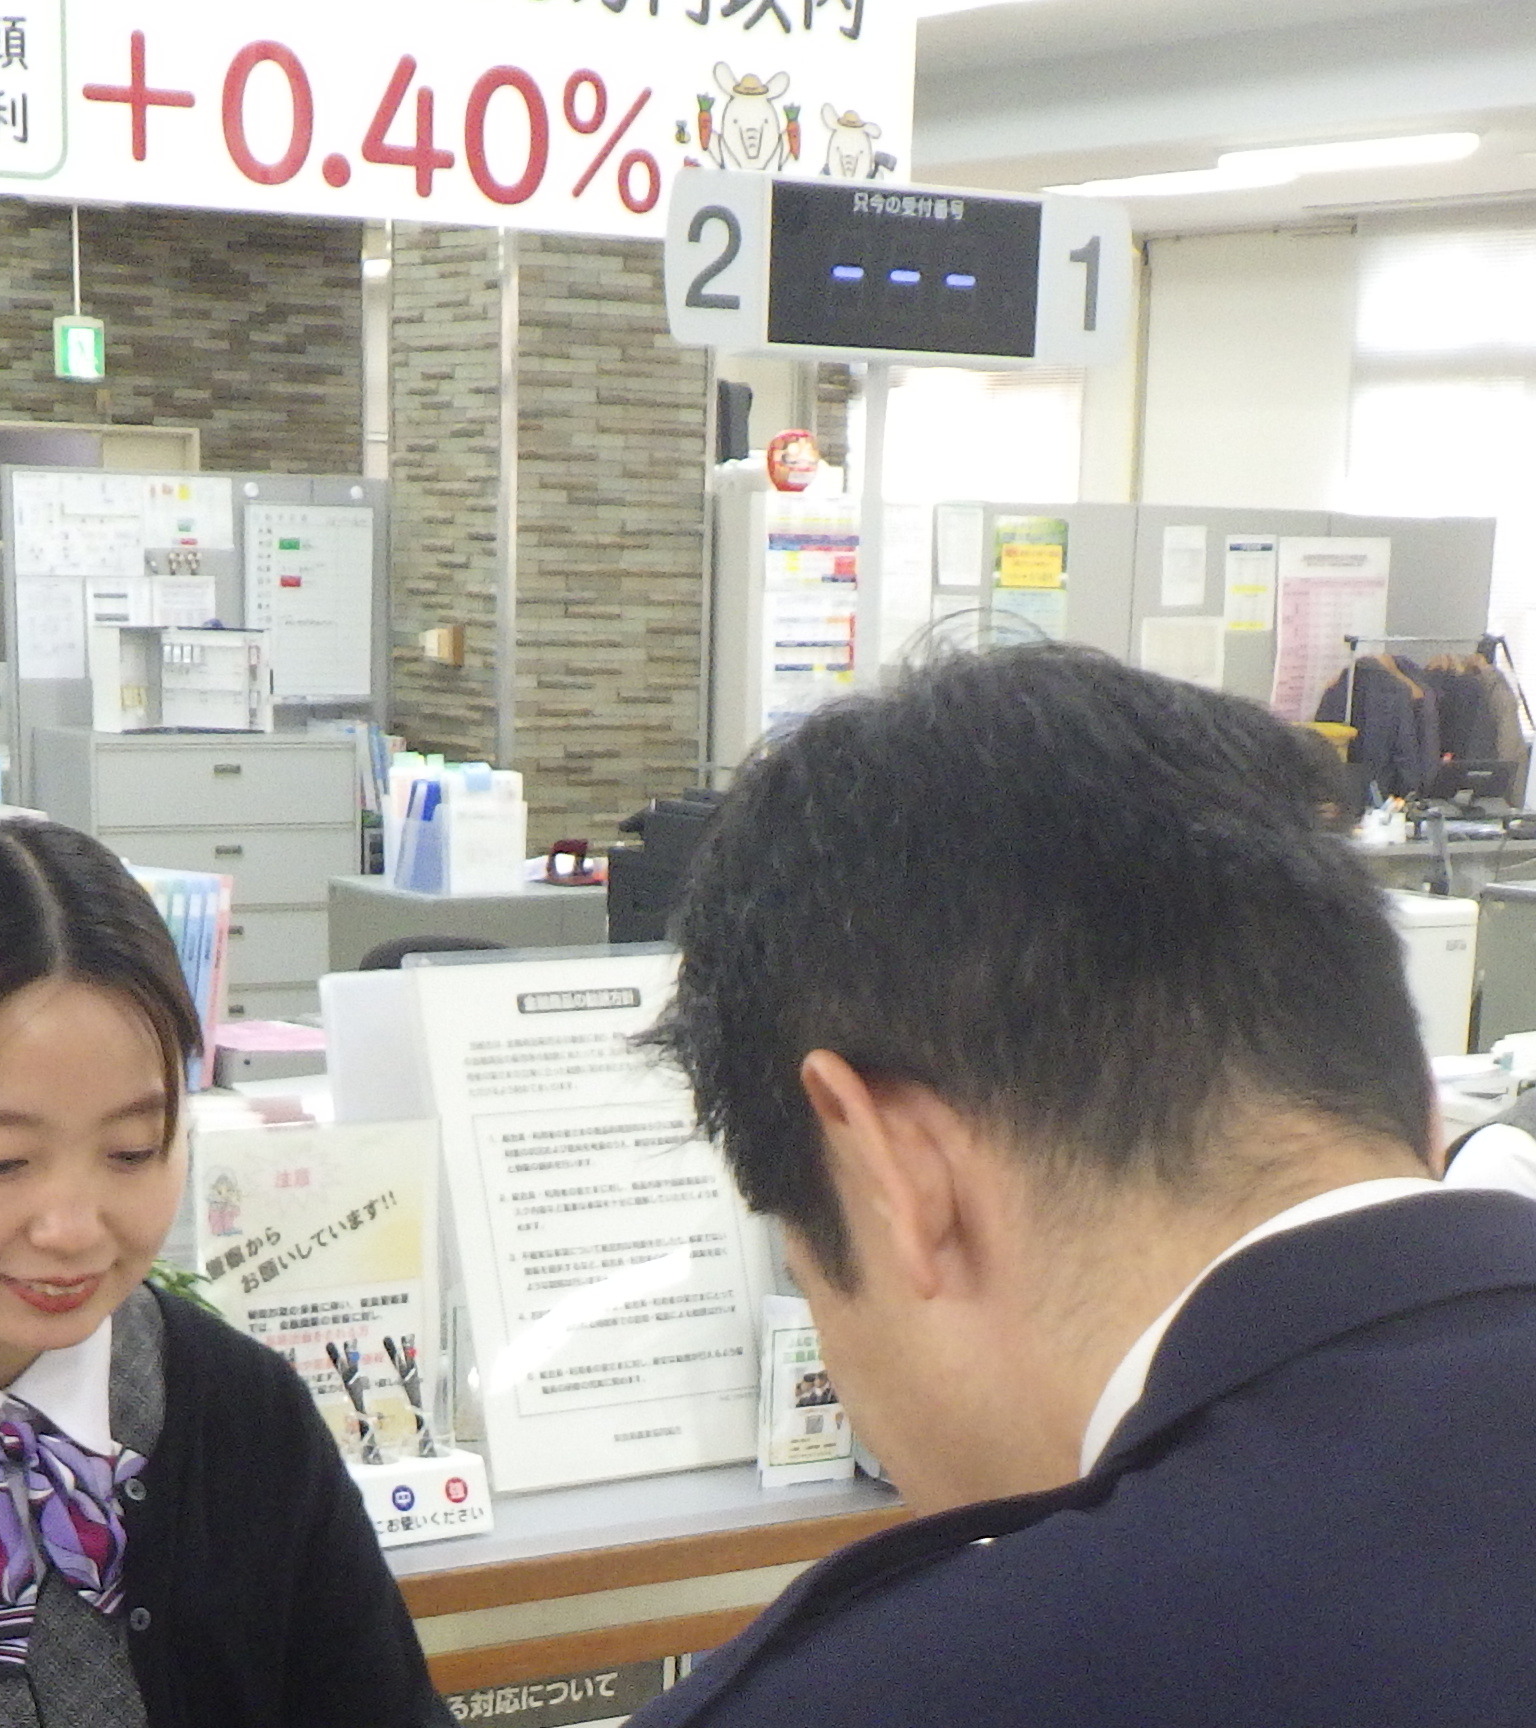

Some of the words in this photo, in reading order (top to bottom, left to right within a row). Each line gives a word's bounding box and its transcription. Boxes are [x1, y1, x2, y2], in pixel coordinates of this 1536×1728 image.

[82, 30, 661, 214] +0.40%
[685, 204, 742, 311] 2
[1068, 235, 1103, 333] 1
